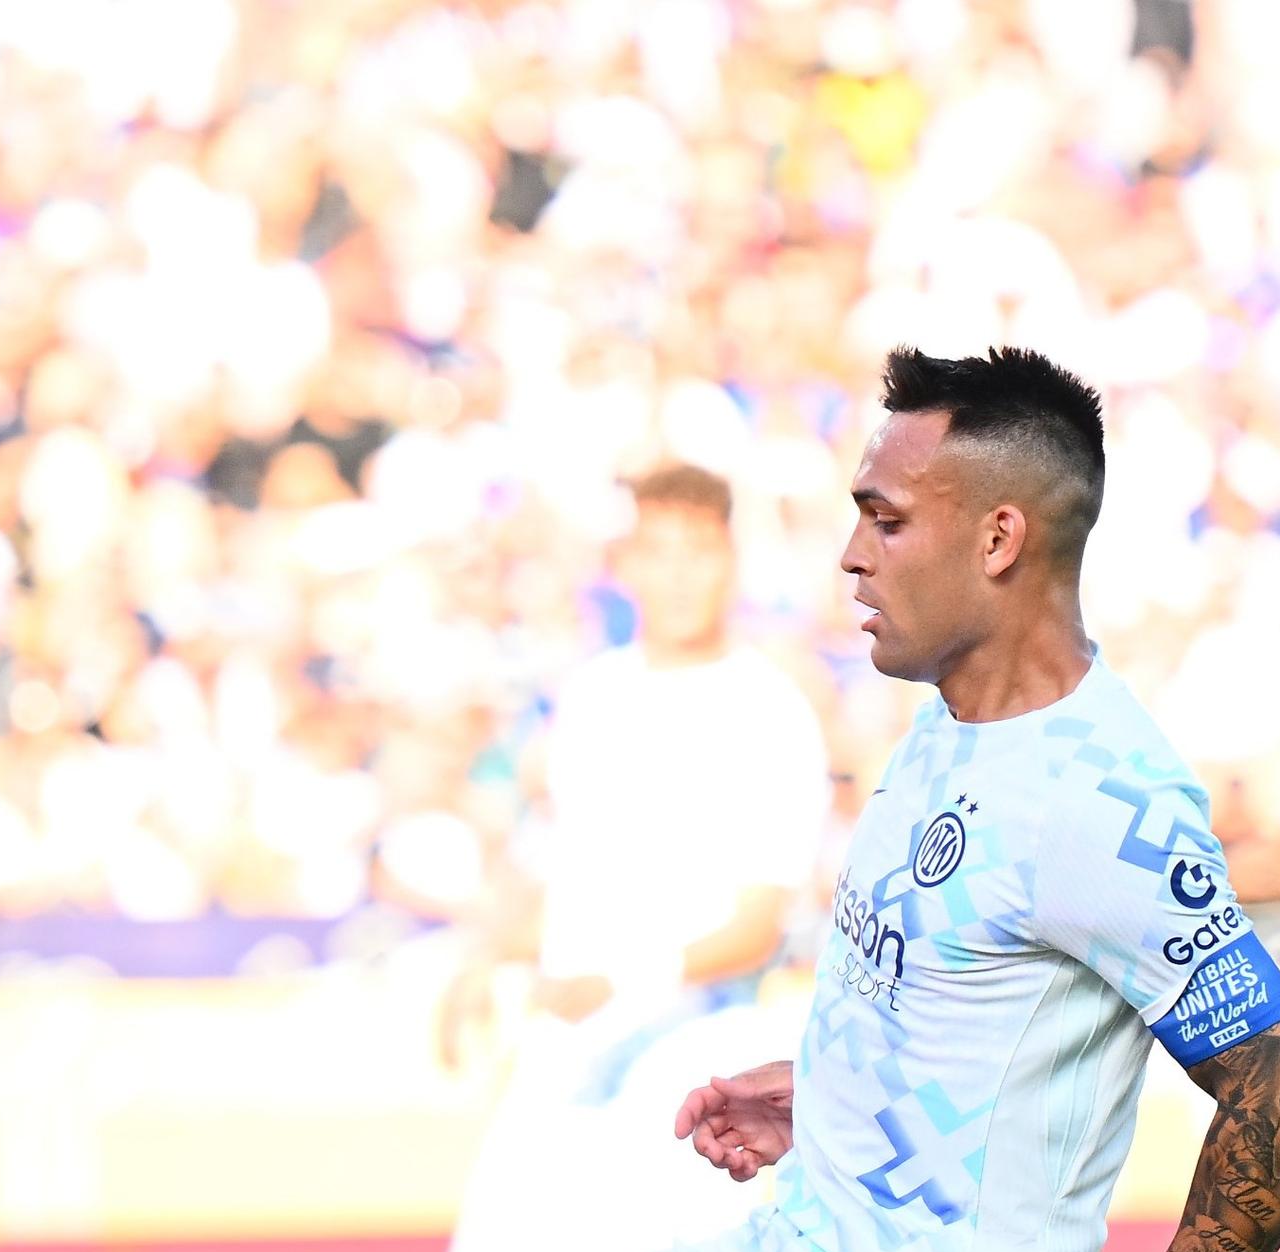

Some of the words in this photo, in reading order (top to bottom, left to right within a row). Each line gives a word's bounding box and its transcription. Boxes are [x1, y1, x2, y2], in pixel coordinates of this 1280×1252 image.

[1174, 963, 1259, 1022] UNITES
[1177, 1021, 1209, 1043] the
[1208, 982, 1269, 1029] World
[1214, 1024, 1248, 1046] FIFA
